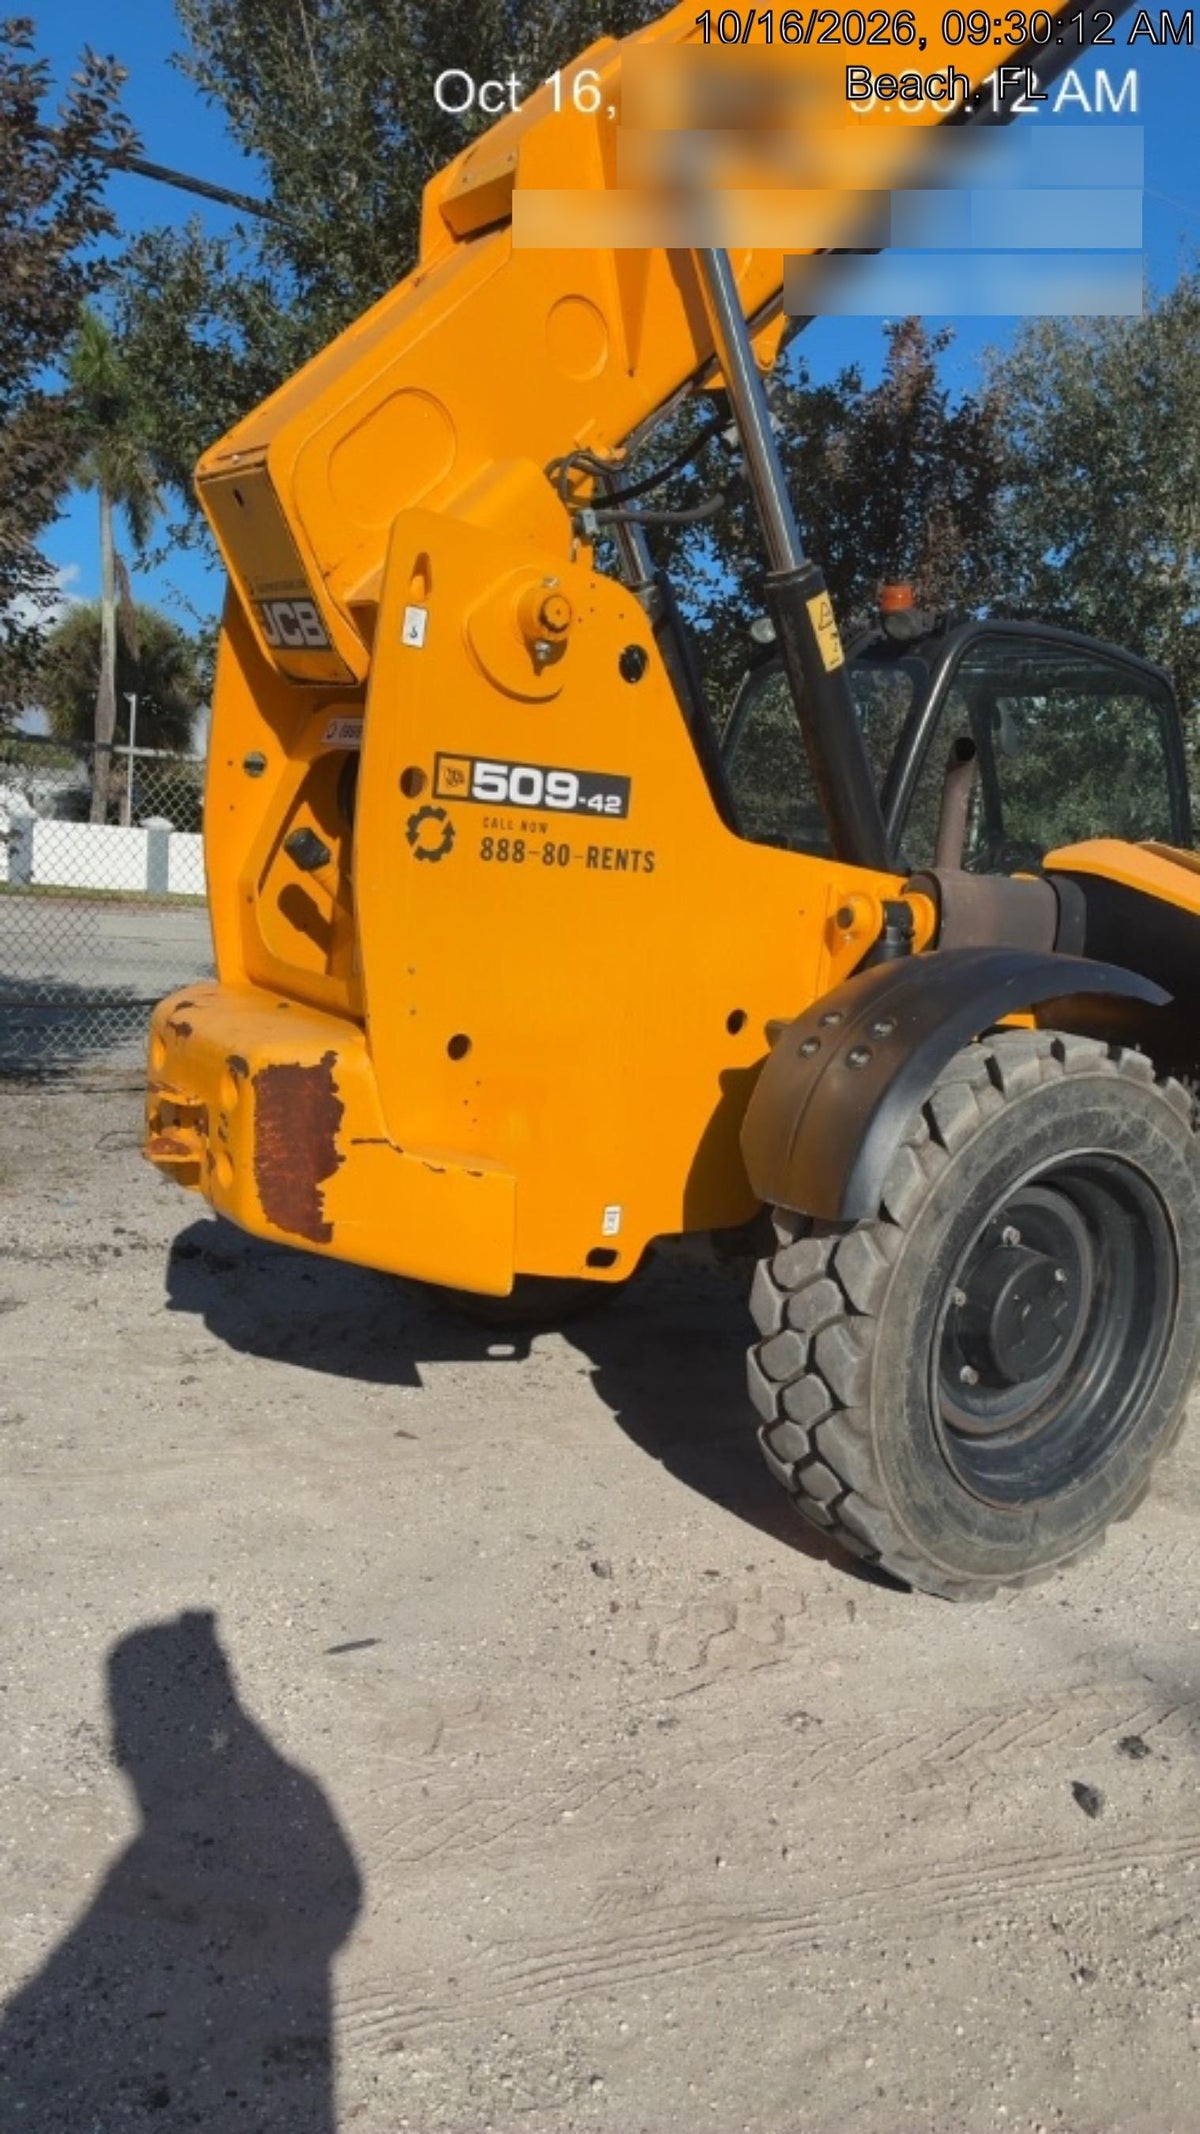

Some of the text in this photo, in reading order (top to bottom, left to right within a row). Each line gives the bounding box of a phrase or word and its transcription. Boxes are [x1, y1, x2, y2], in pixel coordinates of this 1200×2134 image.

[261, 601, 328, 646] JCB
[483, 816, 549, 834] CALL NOW
[480, 836, 656, 873] 888-80-RENTS
